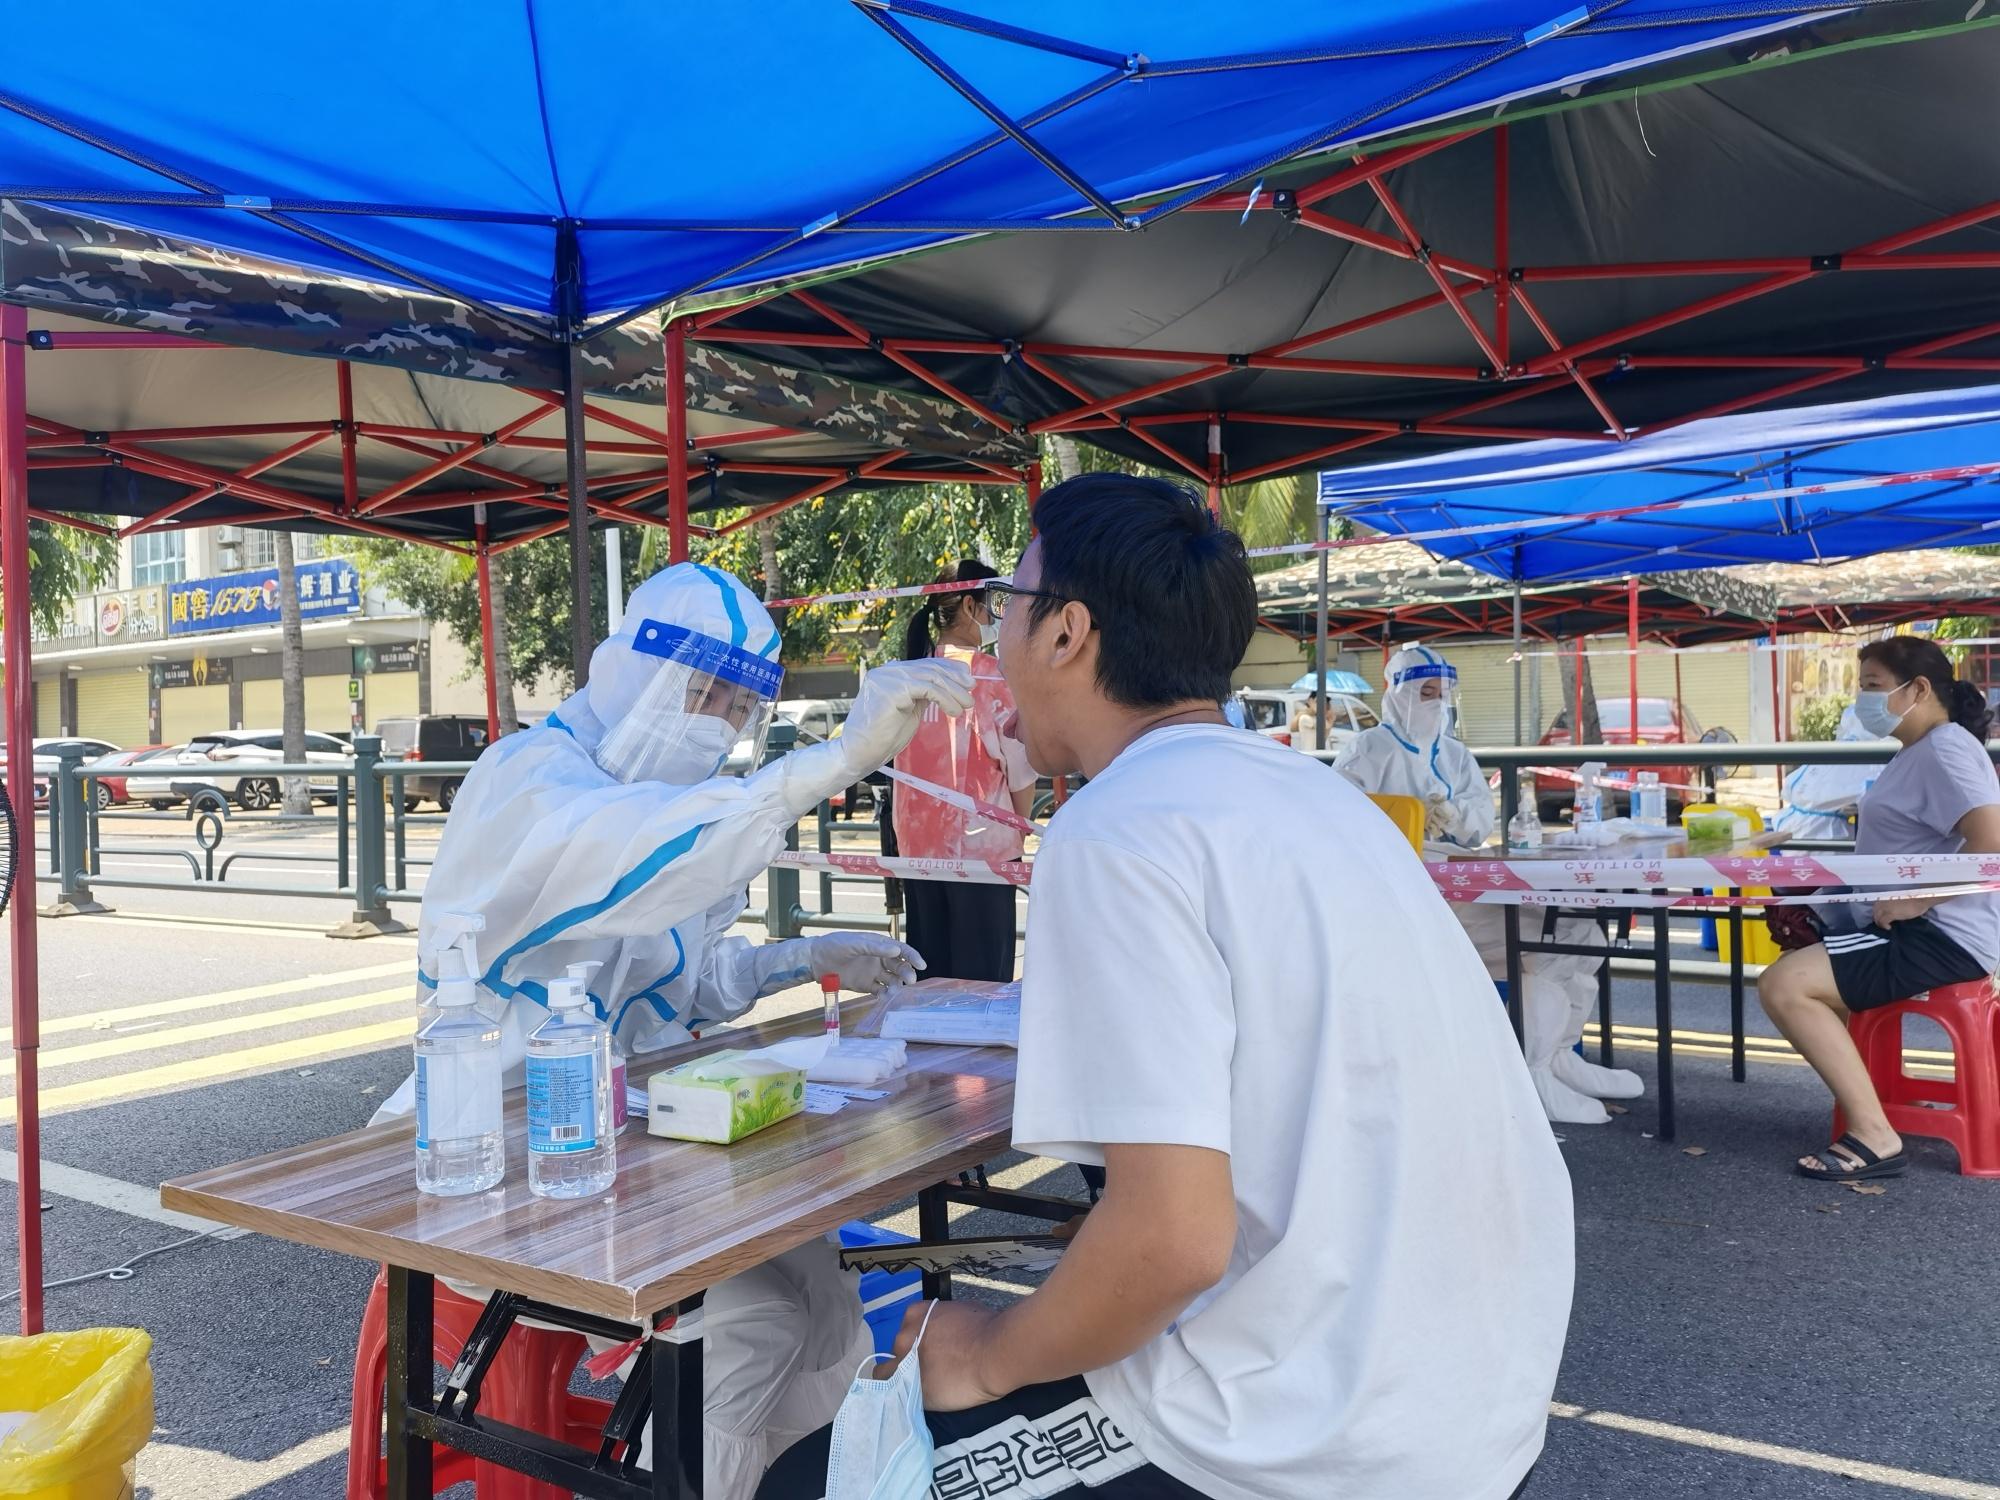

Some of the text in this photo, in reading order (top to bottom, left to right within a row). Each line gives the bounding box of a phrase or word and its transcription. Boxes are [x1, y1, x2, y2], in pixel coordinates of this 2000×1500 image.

[297, 570, 355, 598] 辉酒业
[1520, 894, 1616, 905] CAUTION
[931, 1411, 1133, 1500] PERCE
